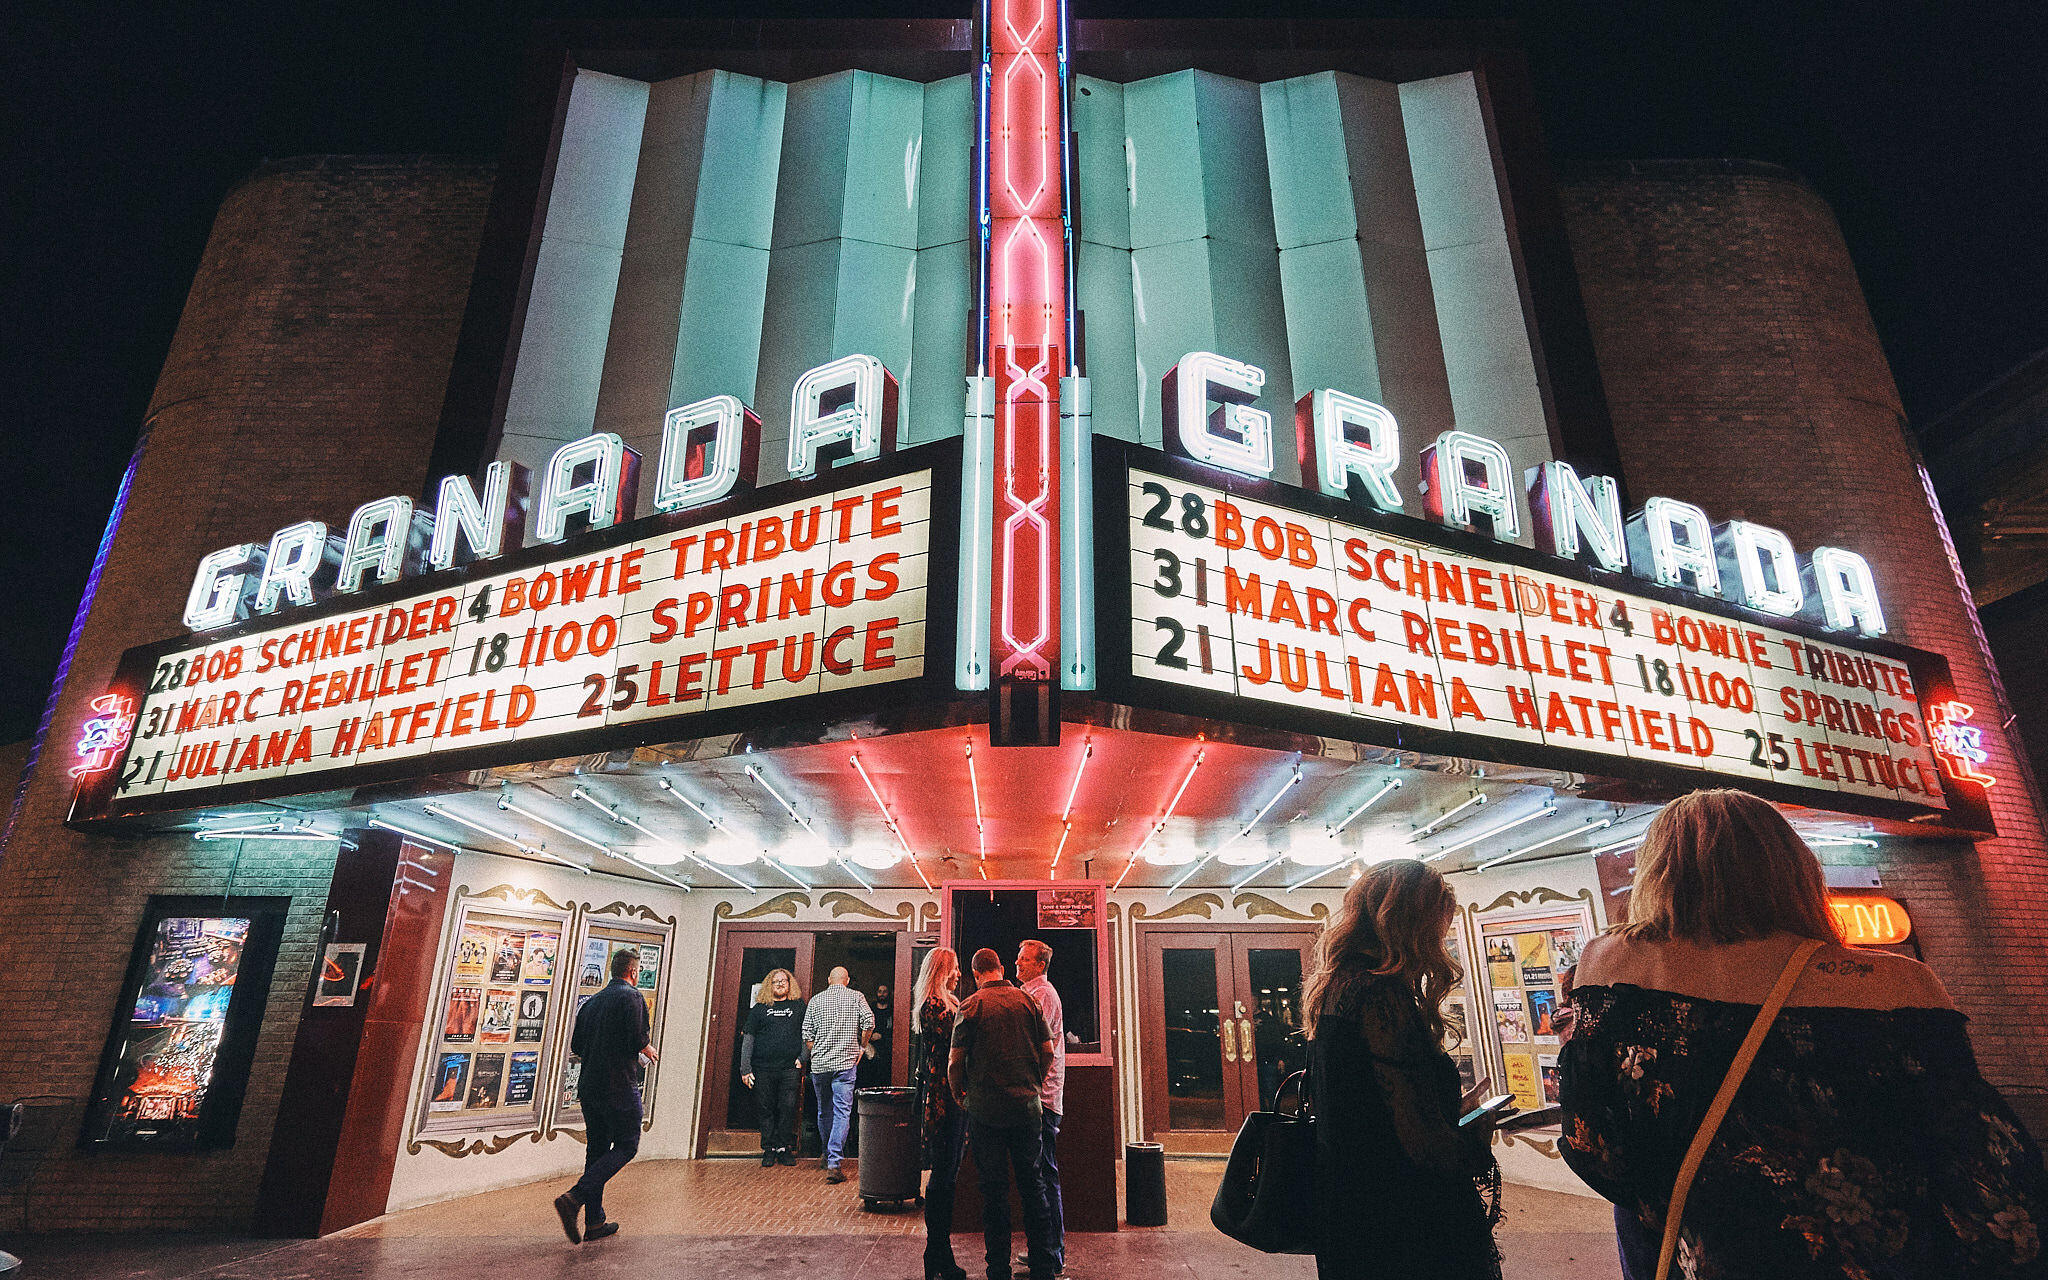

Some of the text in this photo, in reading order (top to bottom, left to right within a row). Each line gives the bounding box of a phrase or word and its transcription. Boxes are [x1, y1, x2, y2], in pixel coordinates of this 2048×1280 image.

[154, 486, 903, 693] 28 BOB SCHNEIDER 4 BOWIE TRIBUTE
[183, 353, 896, 632] GRANADA
[1141, 482, 1918, 701] 28 BOB SCHNEIDER 4 BOWIE TRIBUTE
[1165, 351, 1887, 639] GRANADA
[143, 552, 900, 739] 31 MARC REBILLET 18 1100 SPRINGS
[166, 726, 313, 783] JULIANA
[330, 685, 536, 758] HATFIELD
[577, 664, 640, 719] 25
[646, 616, 900, 707] LETTUCE
[1153, 548, 1922, 748] 31 MARC REBILLET 18 1100 SPRINGS
[1154, 616, 1947, 797] 21 JULIANA HATFIELD 25 LETTUCE
